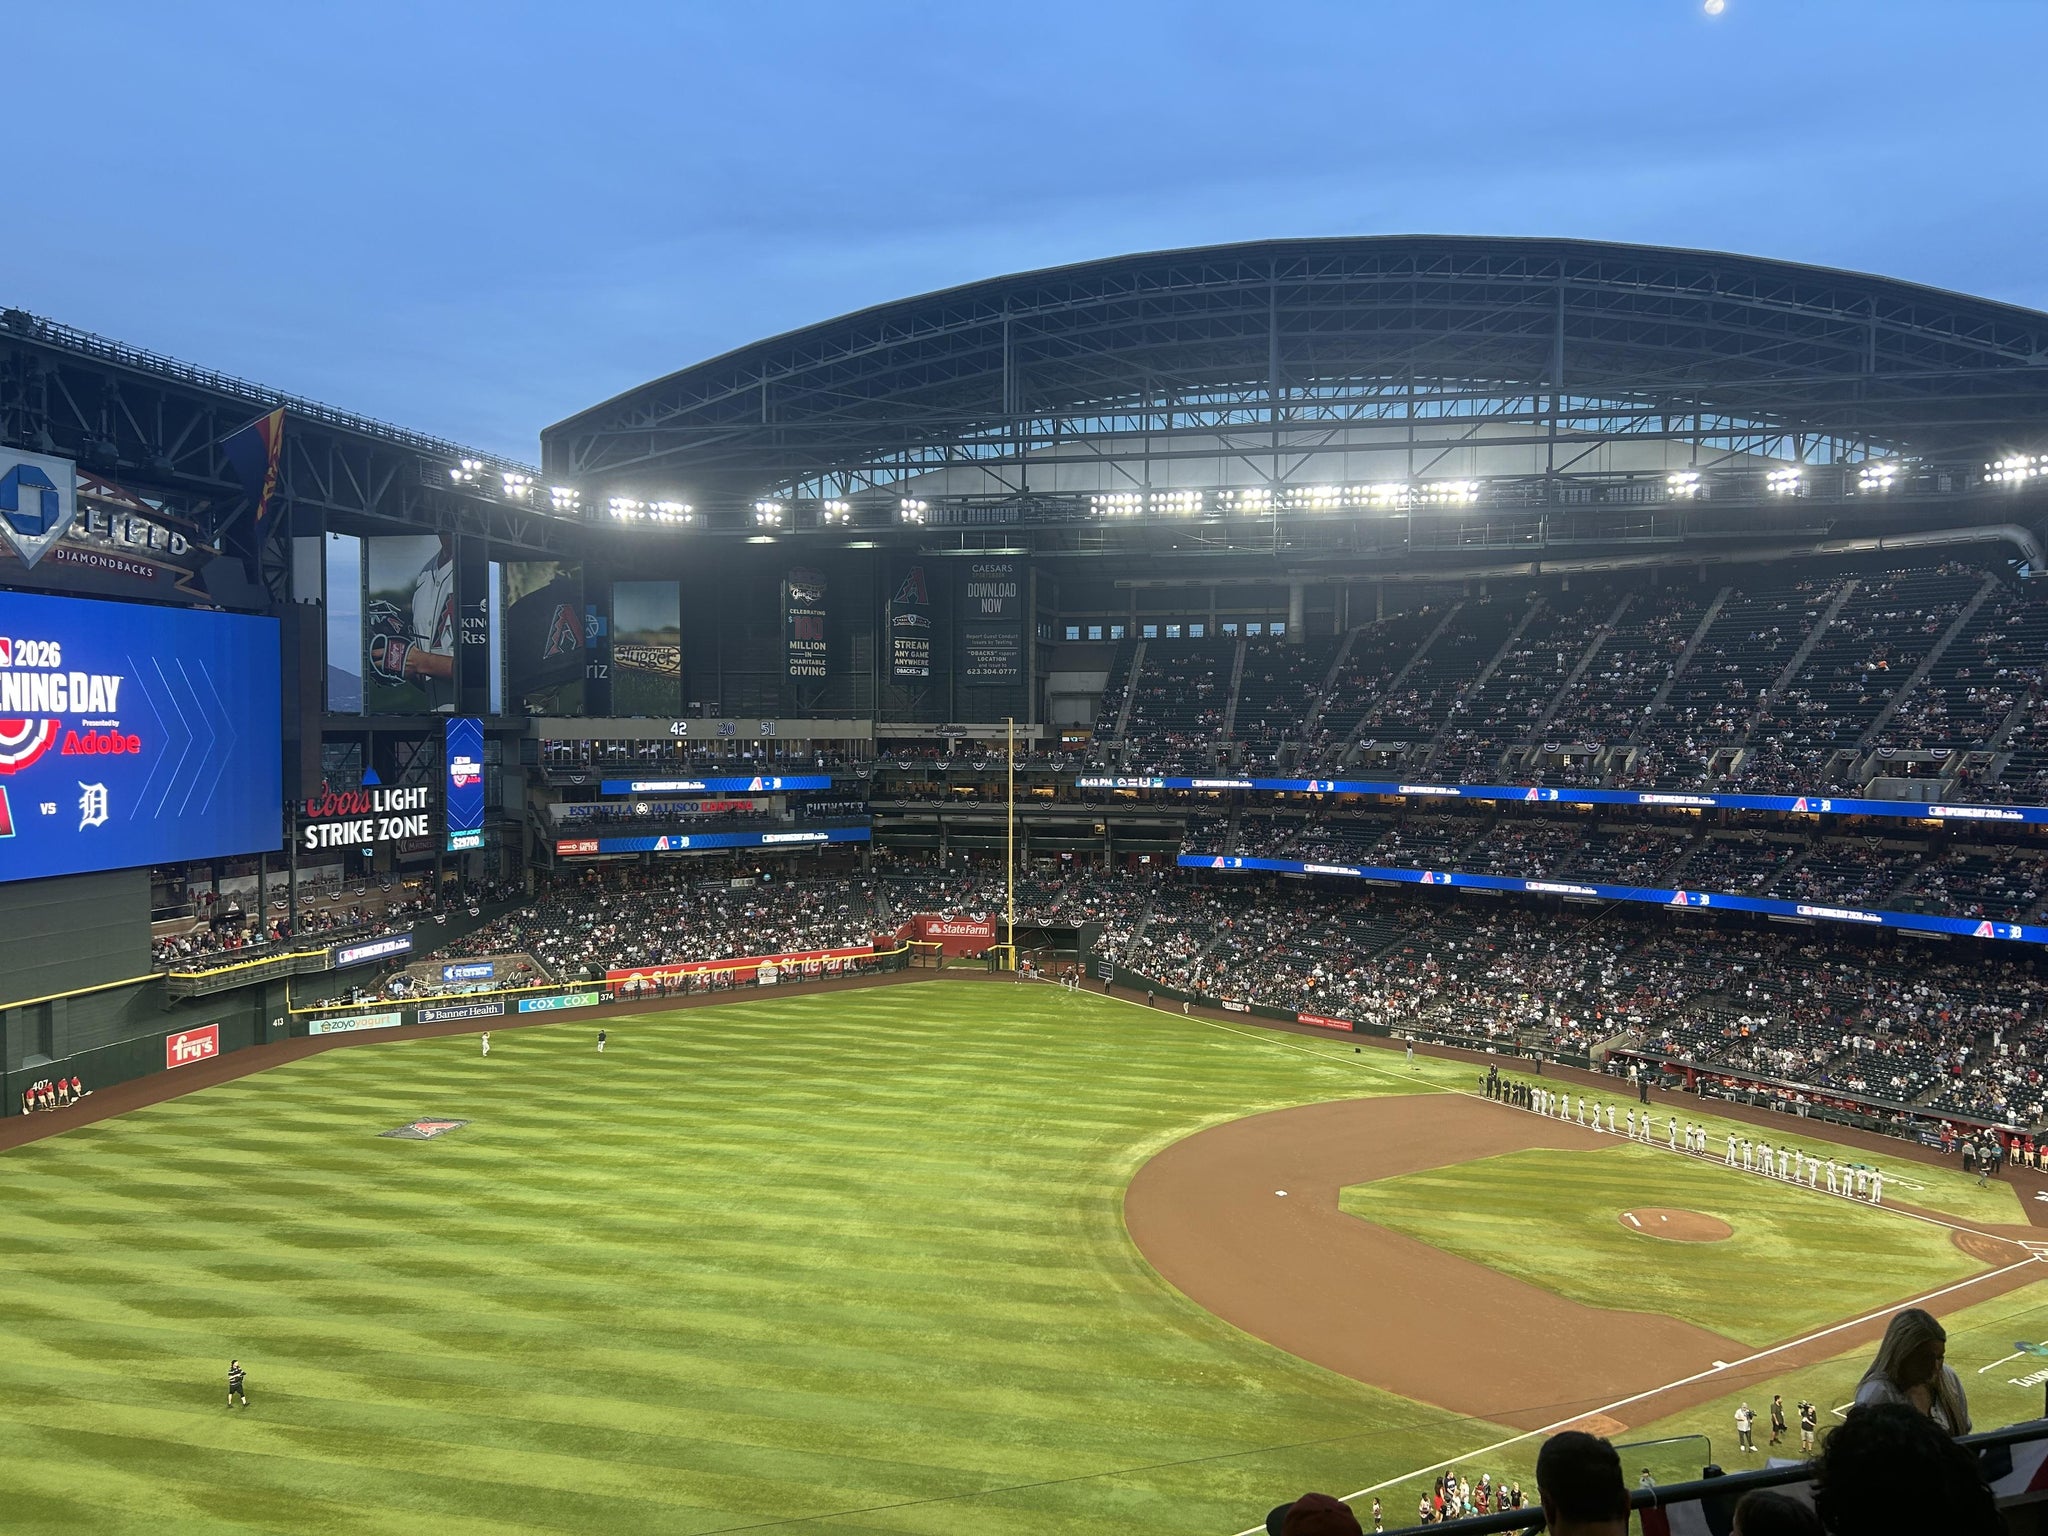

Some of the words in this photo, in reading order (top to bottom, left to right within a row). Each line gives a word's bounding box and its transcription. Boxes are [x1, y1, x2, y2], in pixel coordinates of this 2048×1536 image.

[85, 508, 188, 555] FIELD
[57, 550, 153, 577] DIAMONDBACKS
[972, 564, 1013, 573] CAESARS
[967, 583, 1017, 598] DOWNLOAD
[789, 608, 826, 616] CELEBRATING
[981, 598, 1002, 613] NOW
[789, 641, 826, 651] MILLION
[894, 640, 929, 650] STREAM
[15, 640, 61, 667] 2026
[616, 646, 677, 668] Slugger
[895, 650, 909, 658] ANY
[910, 651, 929, 659] GAME
[895, 658, 929, 666] ANYWHERE
[789, 666, 826, 676] GIVING
[670, 721, 687, 736] 42
[717, 721, 736, 736] 20
[761, 721, 776, 736] 51
[61, 729, 141, 755] Adobe
[1080, 778, 1099, 787] 6:43
[1100, 778, 1113, 787] PM
[306, 780, 372, 818] Coors
[373, 787, 428, 813] LIGHT
[569, 804, 633, 816] ESTRELLA
[650, 802, 699, 813] JALISCO
[701, 800, 754, 813] CANTINA
[305, 819, 374, 849] STRIKE
[378, 814, 429, 841] ZONE
[942, 923, 966, 934] State
[965, 924, 988, 935] Farm
[528, 998, 554, 1010] COX
[563, 995, 590, 1007] COX
[601, 993, 615, 1001] 374
[436, 1010, 468, 1019] Banner
[469, 1005, 498, 1016] Health
[273, 1017, 284, 1027] 413
[172, 1035, 214, 1061] fry's
[32, 1079, 49, 1092] 407
